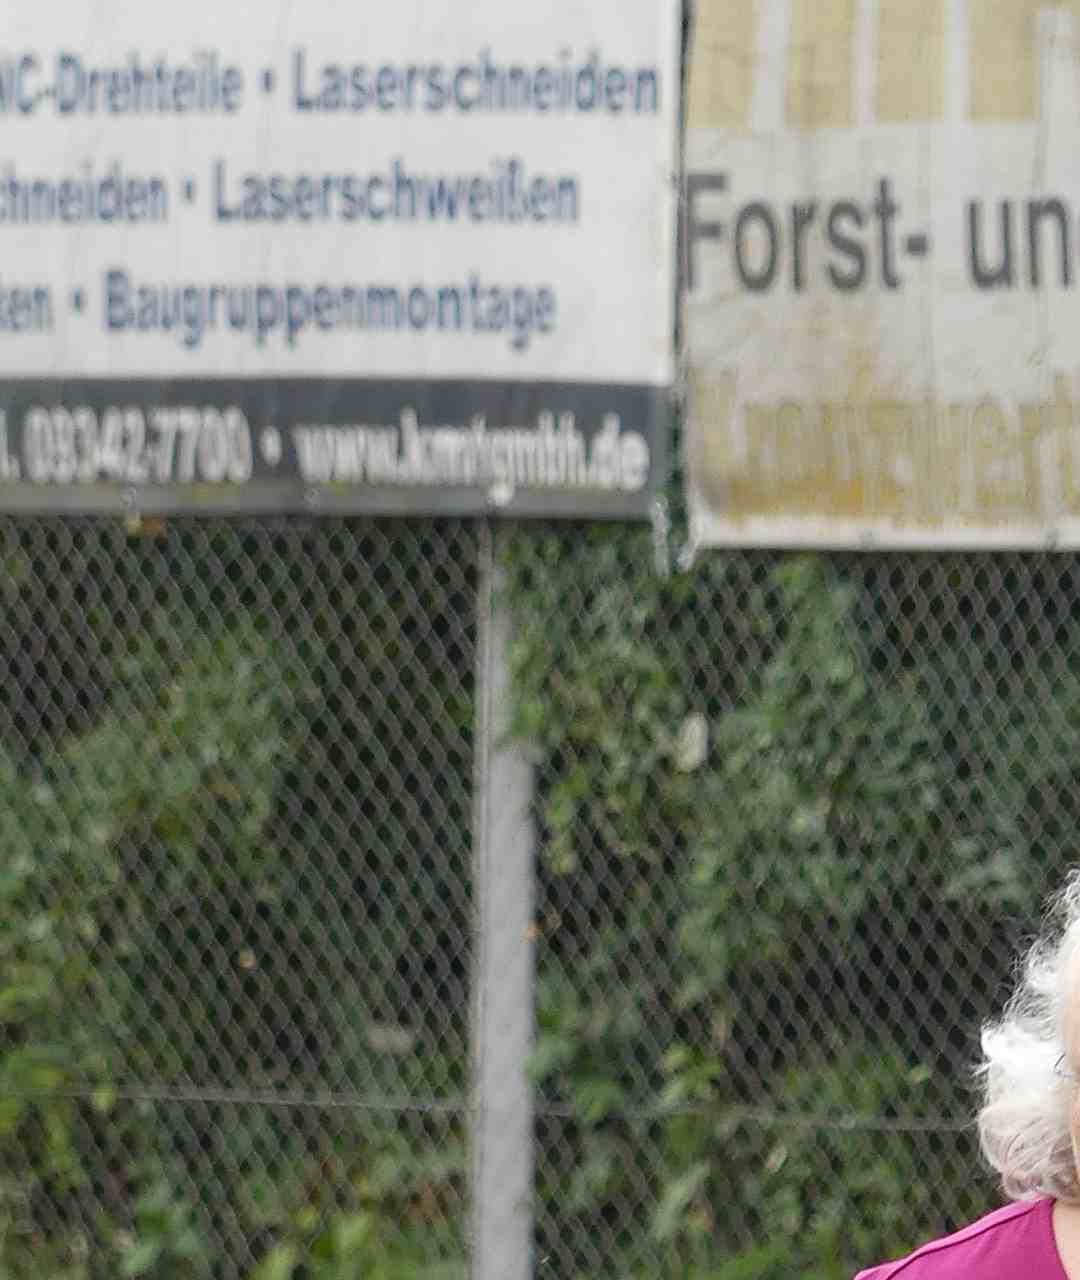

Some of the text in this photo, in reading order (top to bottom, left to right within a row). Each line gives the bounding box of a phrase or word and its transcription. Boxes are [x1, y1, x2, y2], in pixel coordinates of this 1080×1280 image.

[293, 48, 660, 113] Laserschneiden
[213, 158, 579, 224] Laserschweißen
[684, 172, 928, 292] Forst-
[104, 269, 557, 350] Baugruppenmontage
